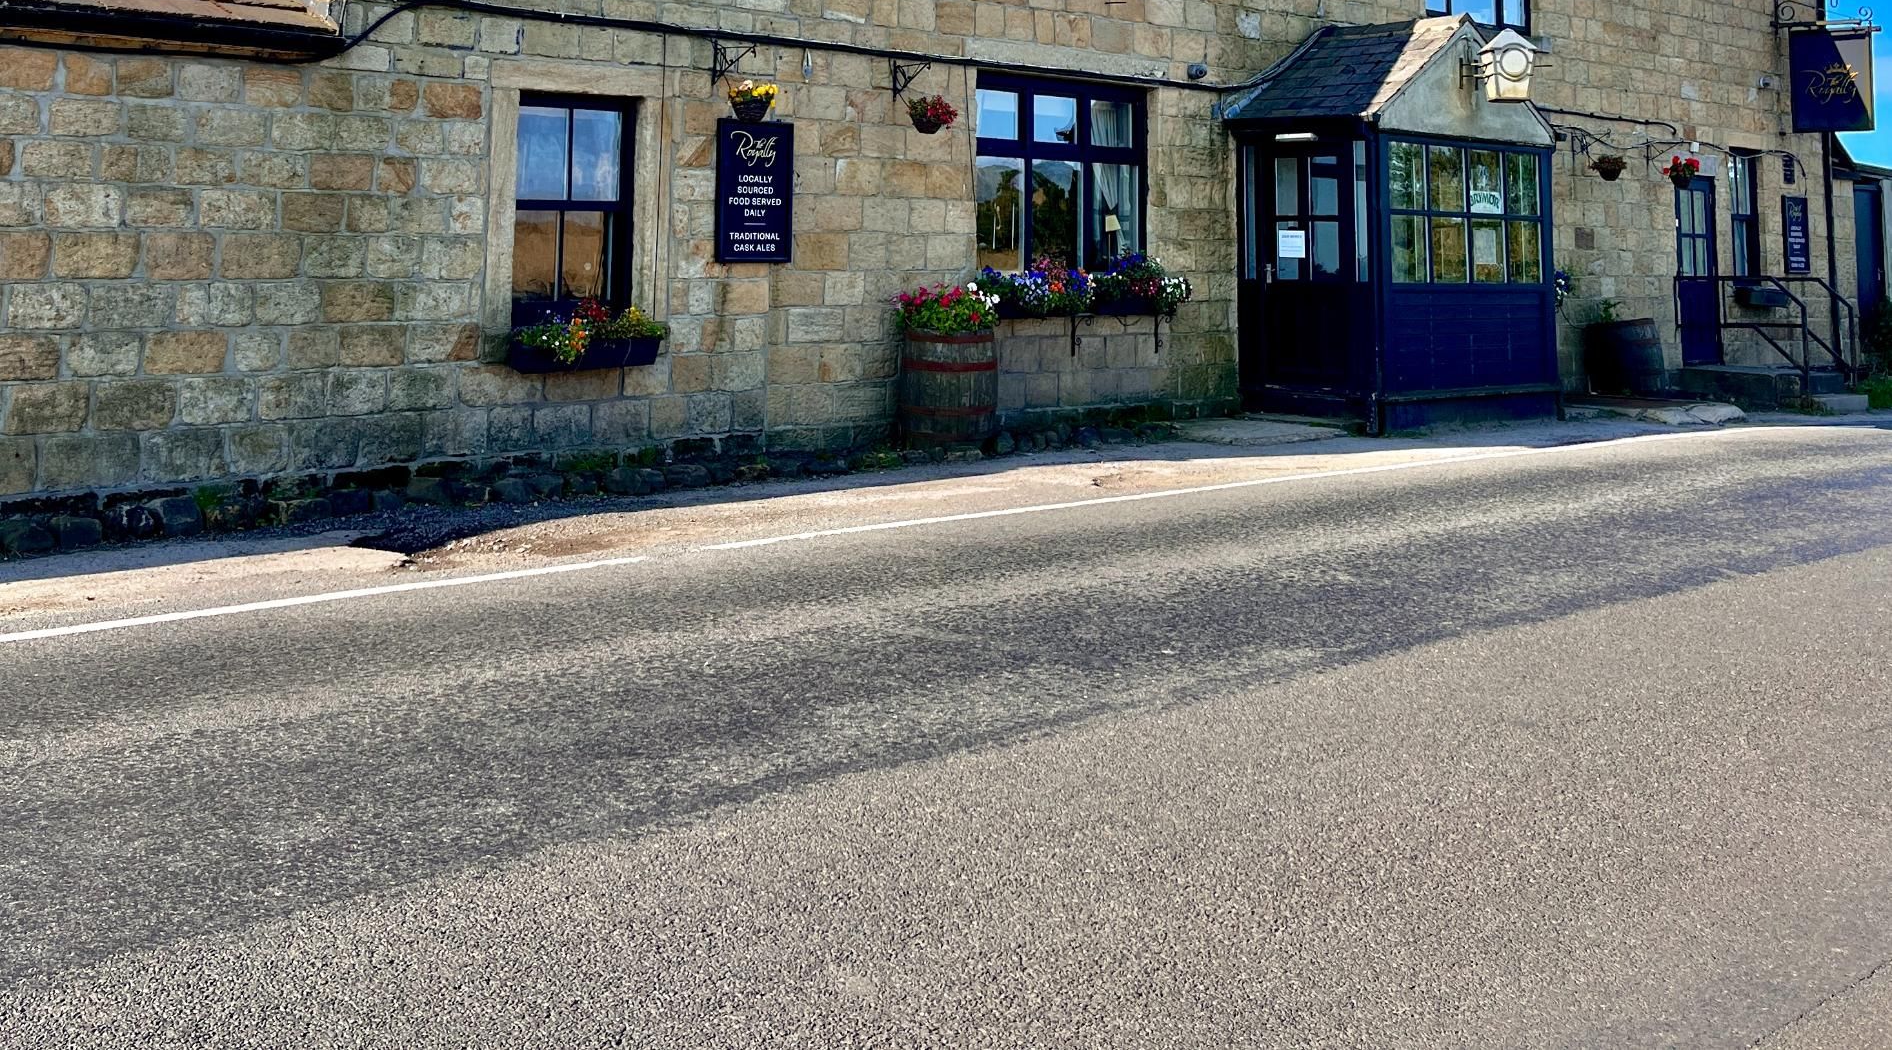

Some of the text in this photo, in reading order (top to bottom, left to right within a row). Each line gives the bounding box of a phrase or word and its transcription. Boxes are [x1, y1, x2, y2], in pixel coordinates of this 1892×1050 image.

[754, 137, 767, 149] The
[730, 130, 779, 168] Royalty
[738, 174, 773, 183] LOCALLY
[737, 185, 774, 195] SOURCED
[728, 196, 782, 206] FOOD SERVED
[744, 208, 766, 217] DAILY
[729, 232, 780, 240] TRADITIONAL
[733, 243, 776, 252] CASK ALES
